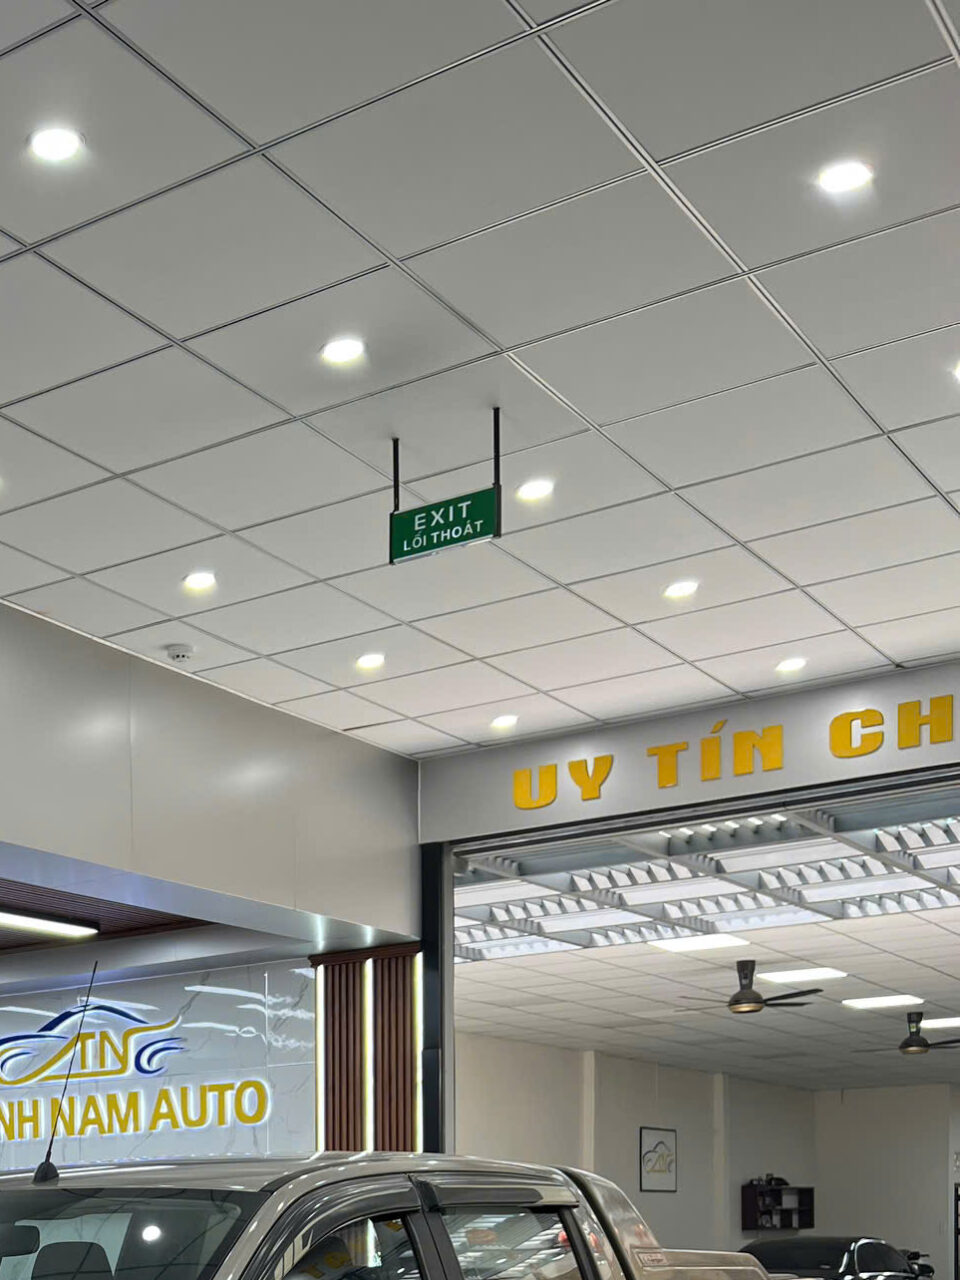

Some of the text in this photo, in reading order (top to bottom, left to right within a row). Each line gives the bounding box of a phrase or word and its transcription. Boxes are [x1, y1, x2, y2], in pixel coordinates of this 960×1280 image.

[414, 501, 472, 531] EXIT
[430, 520, 484, 544] THOÁT
[513, 694, 954, 810] UY TÍN CH
[49, 1091, 139, 1137] NAM
[149, 1079, 268, 1131] AUTO
